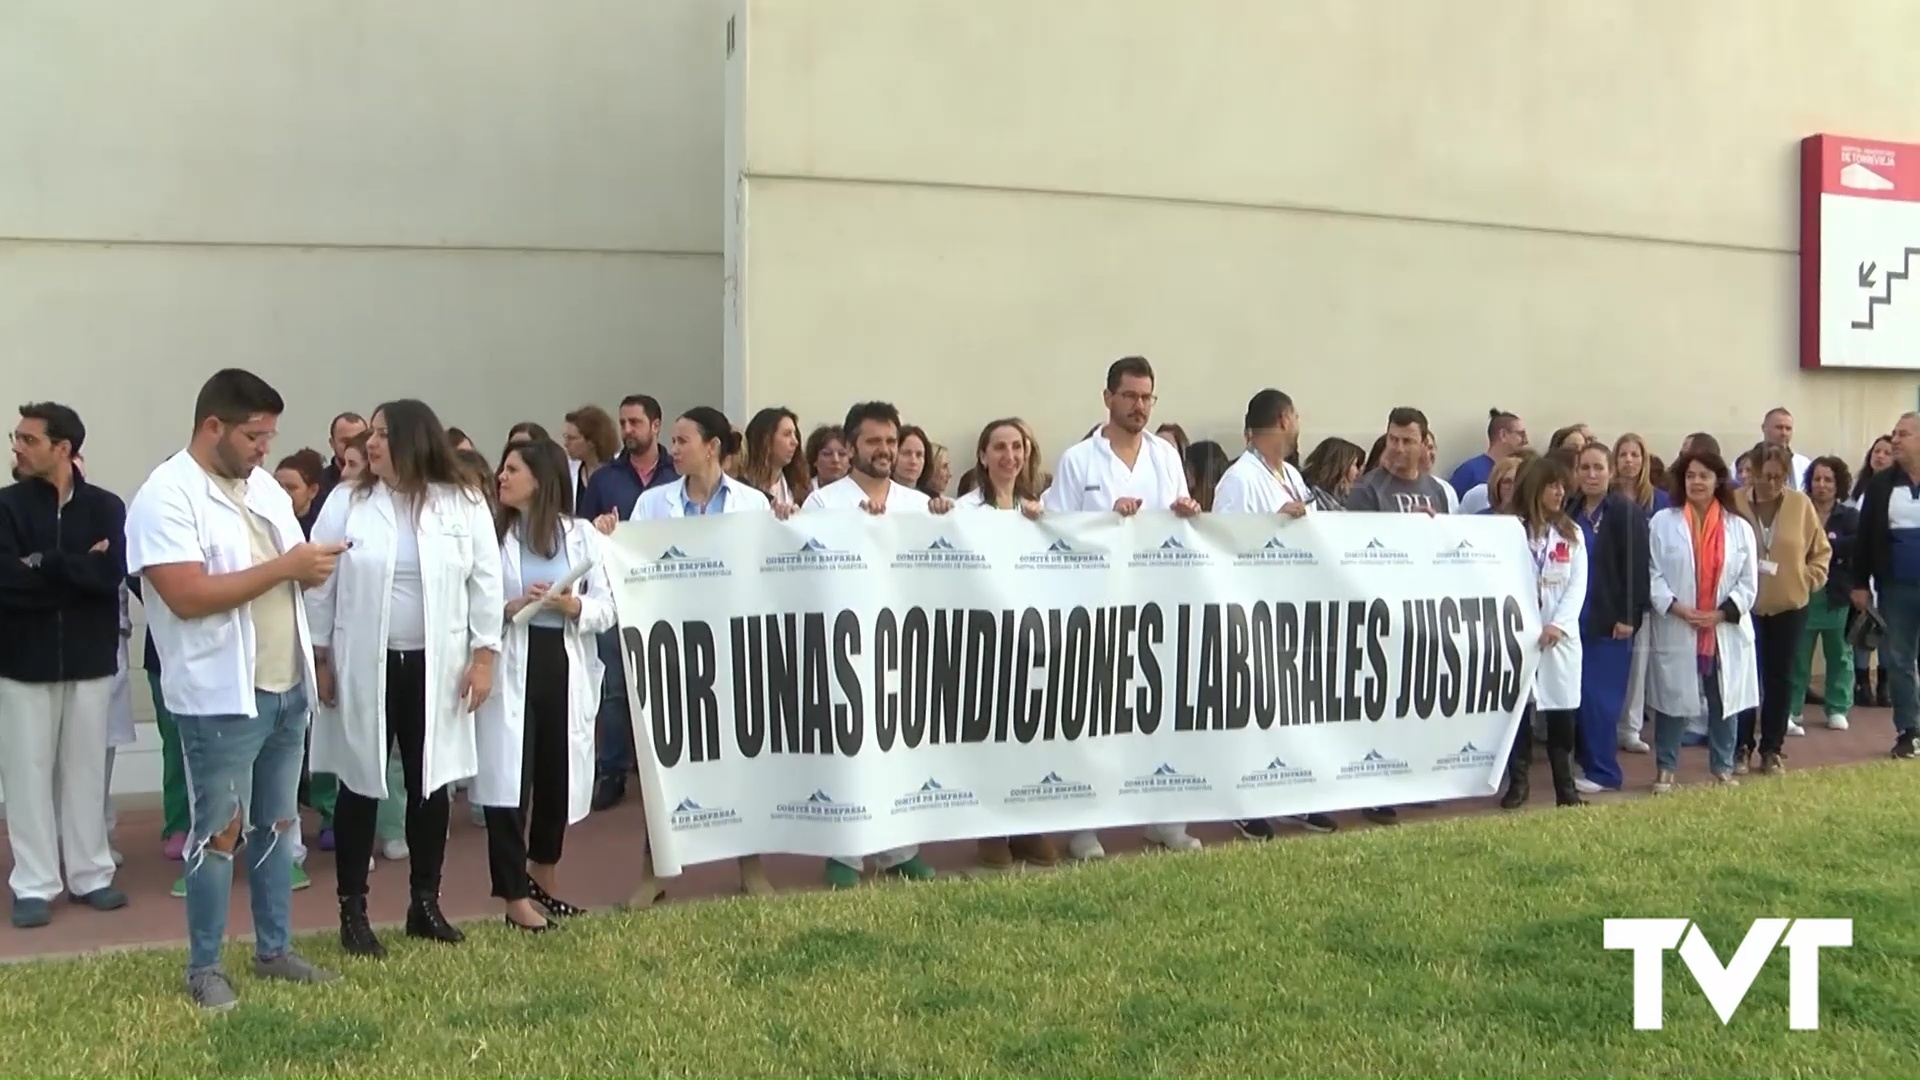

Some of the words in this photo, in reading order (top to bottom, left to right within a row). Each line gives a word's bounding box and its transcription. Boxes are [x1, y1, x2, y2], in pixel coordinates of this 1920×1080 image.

[766, 554, 802, 565] COMITÉ
[804, 555, 817, 563] DE
[819, 554, 862, 563] EMPRESA
[896, 551, 929, 561] COMITÉ
[1019, 553, 1049, 563] COMITÉ
[1051, 555, 1062, 563] DE
[1064, 555, 1105, 563] EMPRESA
[664, 563, 677, 572] DE
[622, 620, 720, 768] POR
[730, 609, 863, 758] UNAS
[875, 602, 1163, 752] CONDICIONES
[1174, 598, 1390, 731] LABORALES
[1396, 595, 1524, 719] JUSTAS
[1156, 778, 1167, 786] DE
[811, 806, 822, 814] DE
[679, 816, 691, 824] DE
